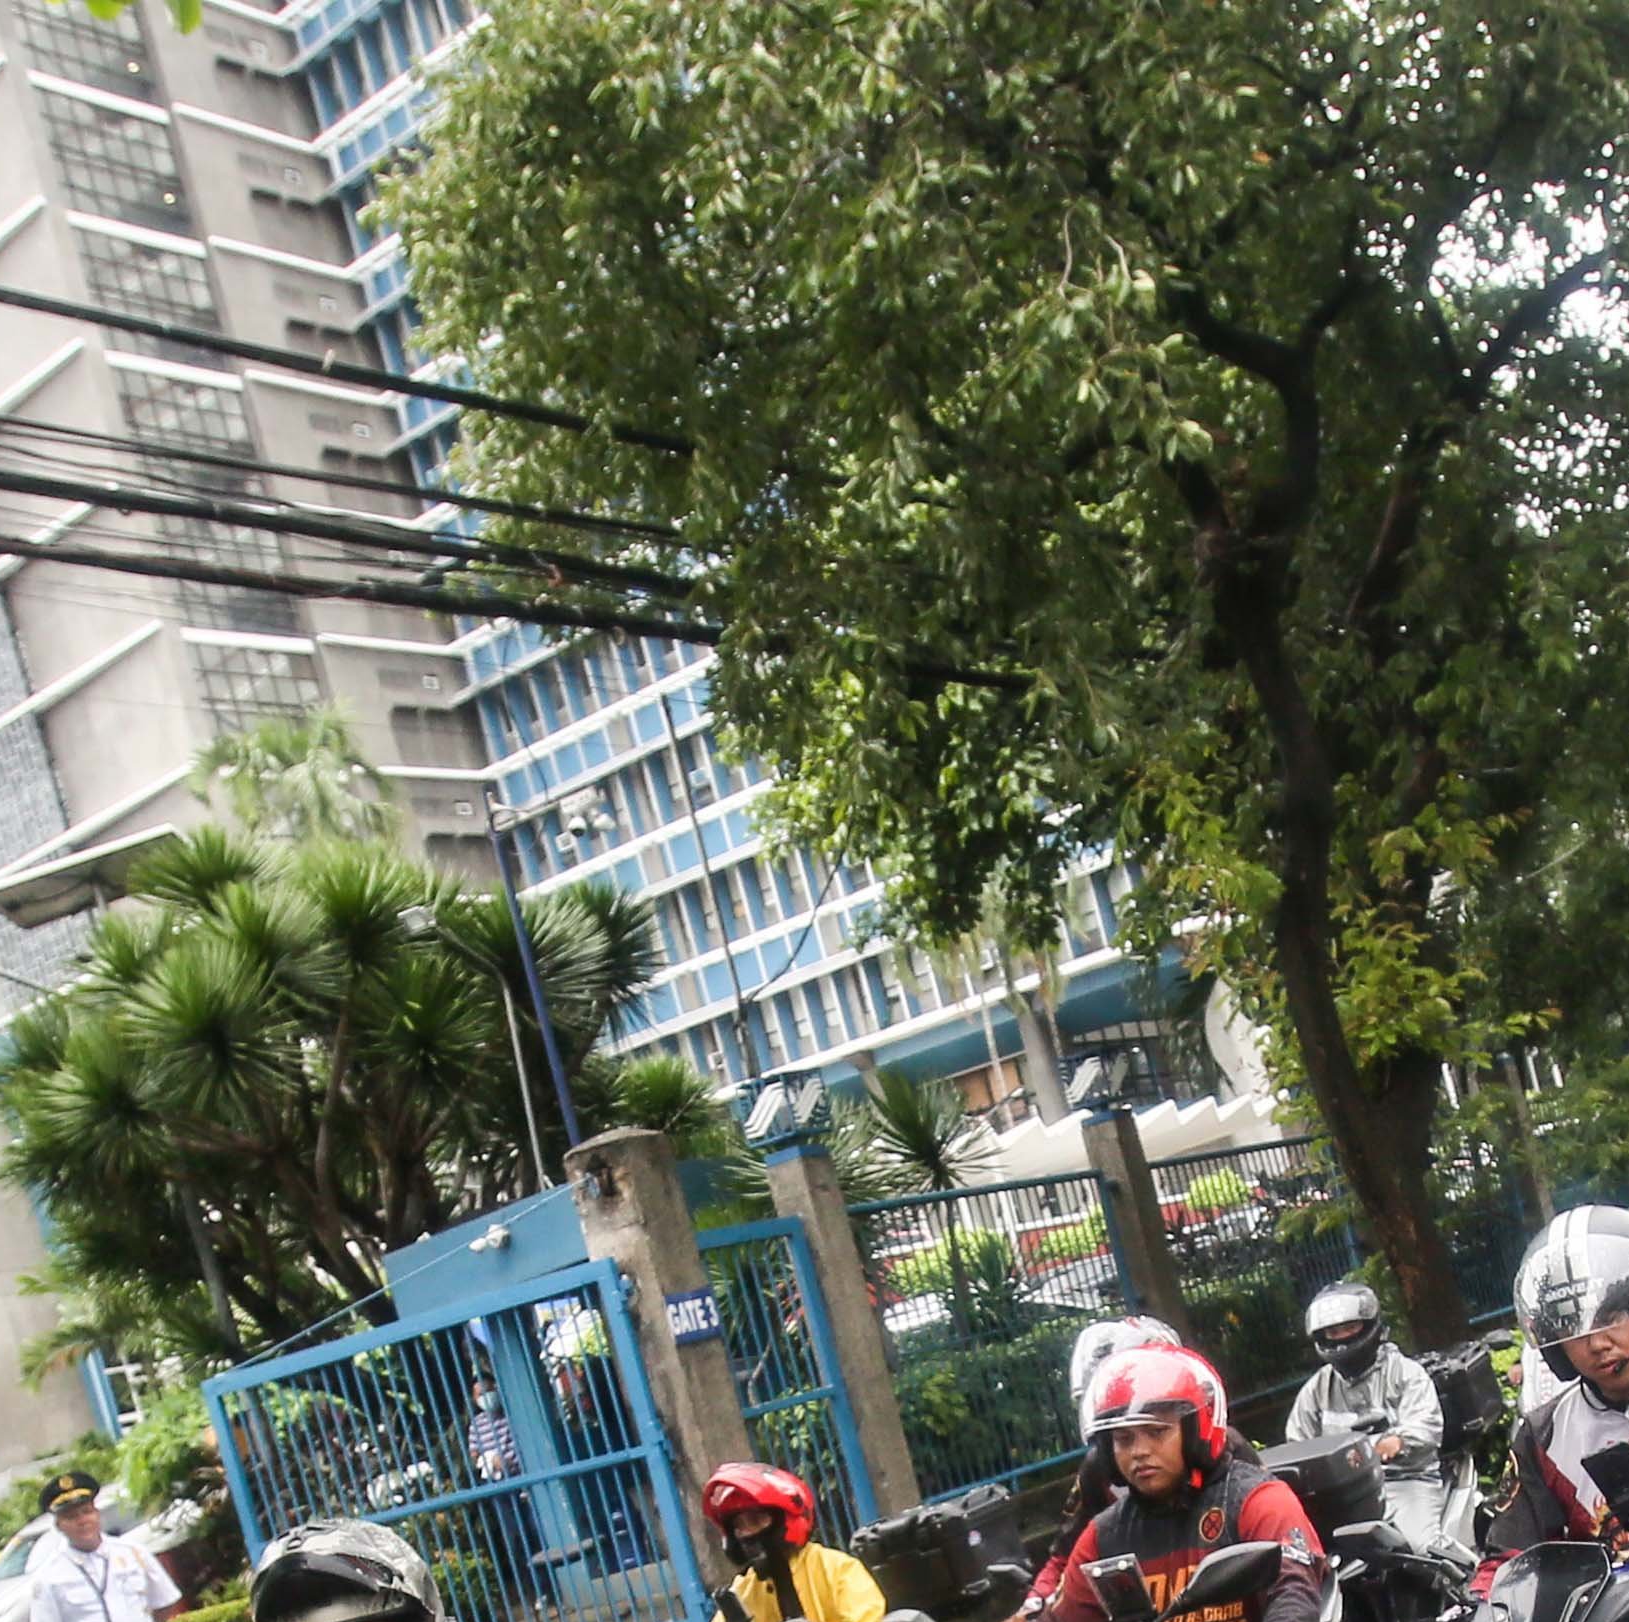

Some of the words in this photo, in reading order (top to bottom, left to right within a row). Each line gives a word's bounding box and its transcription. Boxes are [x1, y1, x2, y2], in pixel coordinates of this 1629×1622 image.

[666, 1298, 709, 1335] GATE
[705, 1295, 720, 1327] 3
[1203, 1602, 1244, 1622] GRAB
